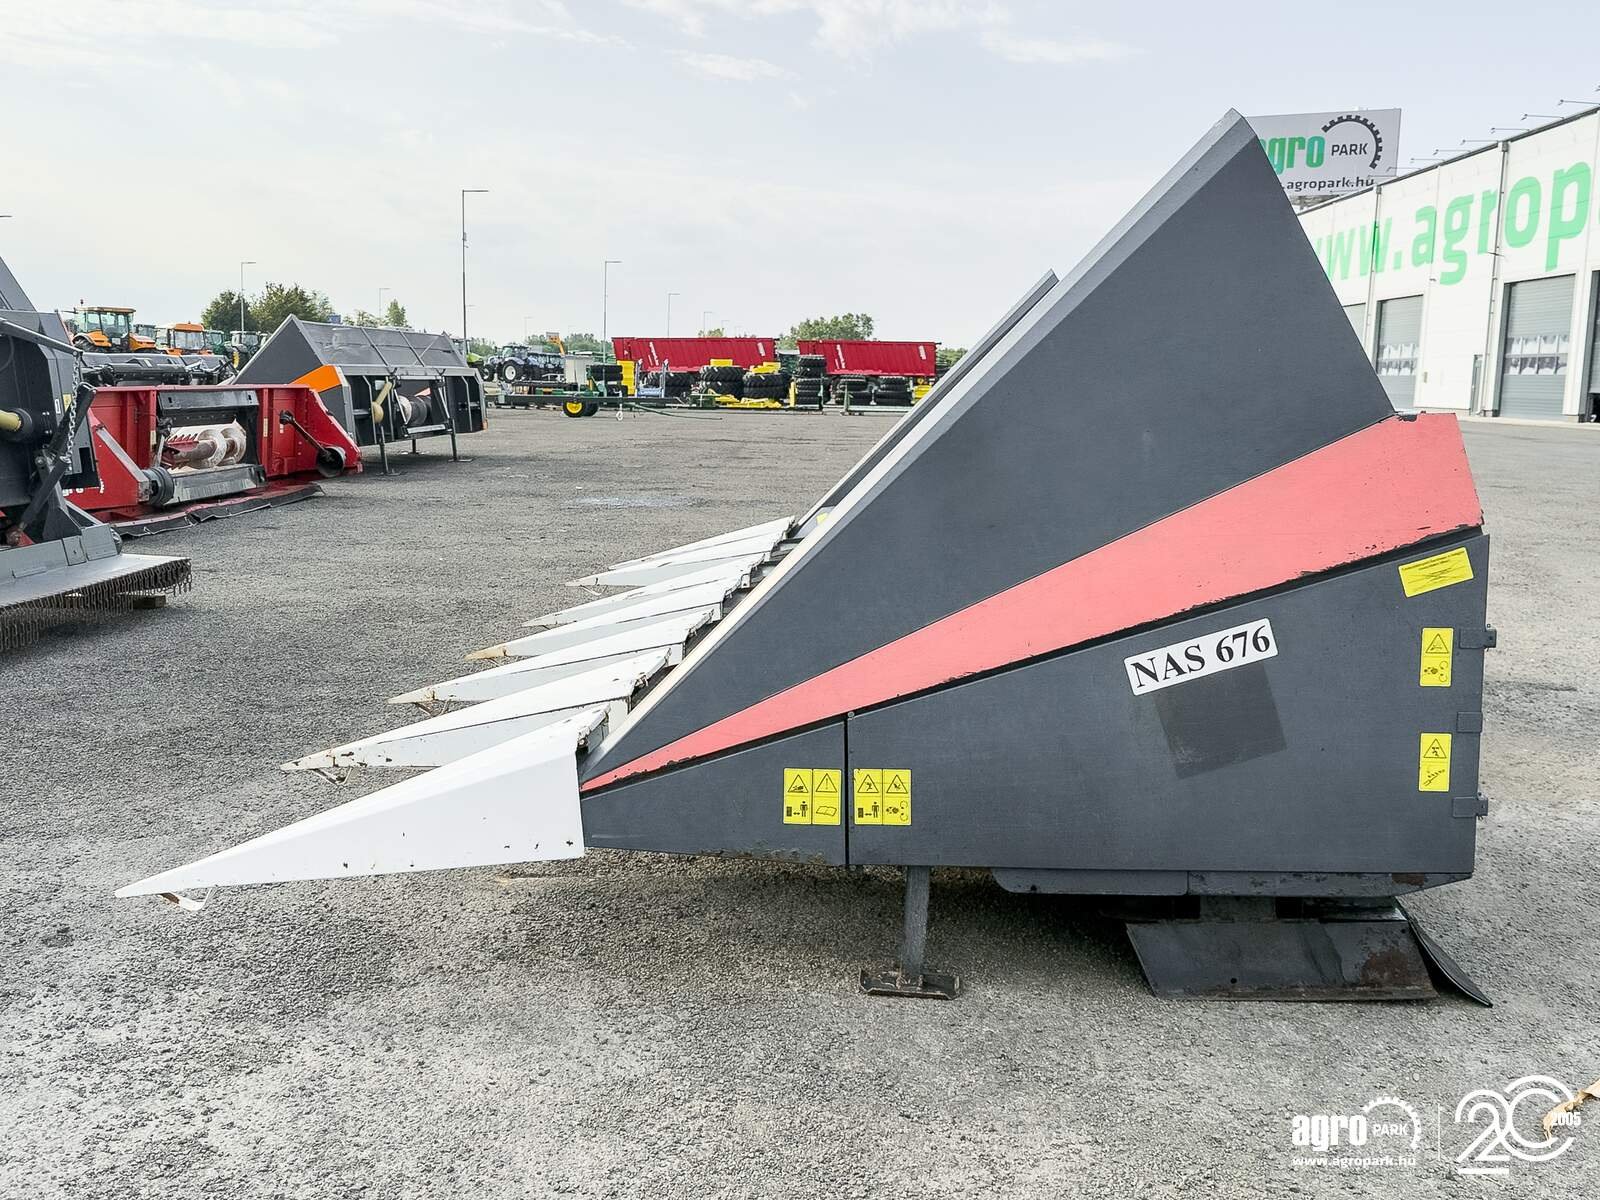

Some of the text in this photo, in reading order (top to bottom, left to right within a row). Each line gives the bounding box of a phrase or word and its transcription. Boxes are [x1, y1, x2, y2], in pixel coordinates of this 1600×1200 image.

[1260, 136, 1326, 175] gro
[1331, 143, 1369, 156] PARK
[1314, 161, 1600, 286] ww.agrop
[1131, 625, 1270, 688] NAS 676
